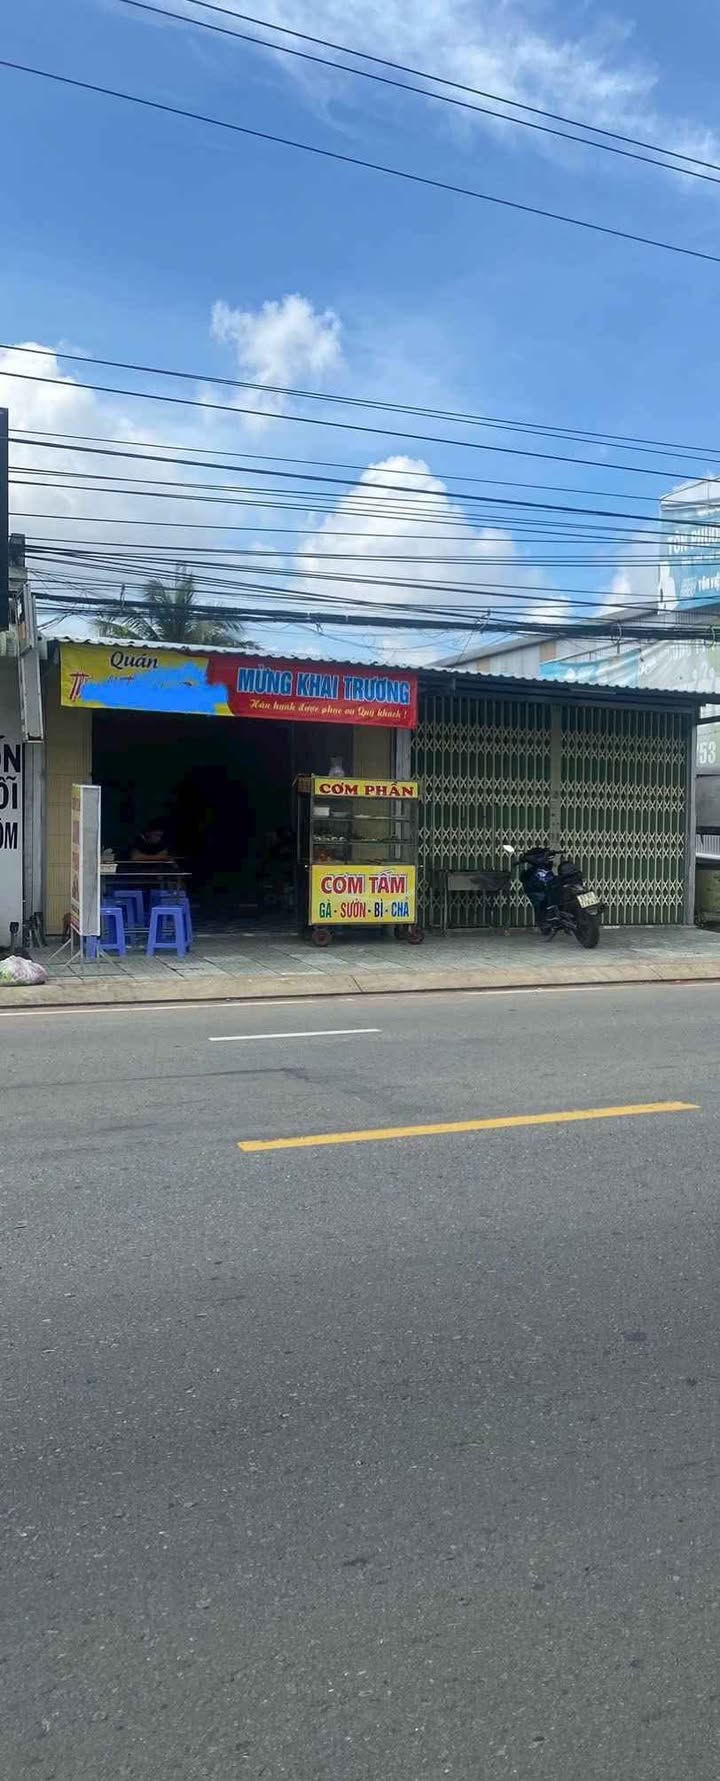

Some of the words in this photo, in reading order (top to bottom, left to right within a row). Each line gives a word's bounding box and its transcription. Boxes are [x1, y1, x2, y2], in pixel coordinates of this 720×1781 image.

[110, 651, 158, 669] Quán
[237, 664, 293, 696] MỪNG
[296, 672, 339, 700] KHAI
[343, 675, 410, 705] TRƯƠNG
[319, 782, 358, 796] CƠM
[320, 873, 364, 894] CƠM
[369, 868, 407, 894] TẤM
[320, 899, 331, 918] GÀ
[340, 898, 366, 918] SƯỜN
[391, 895, 409, 917] CHẢ
